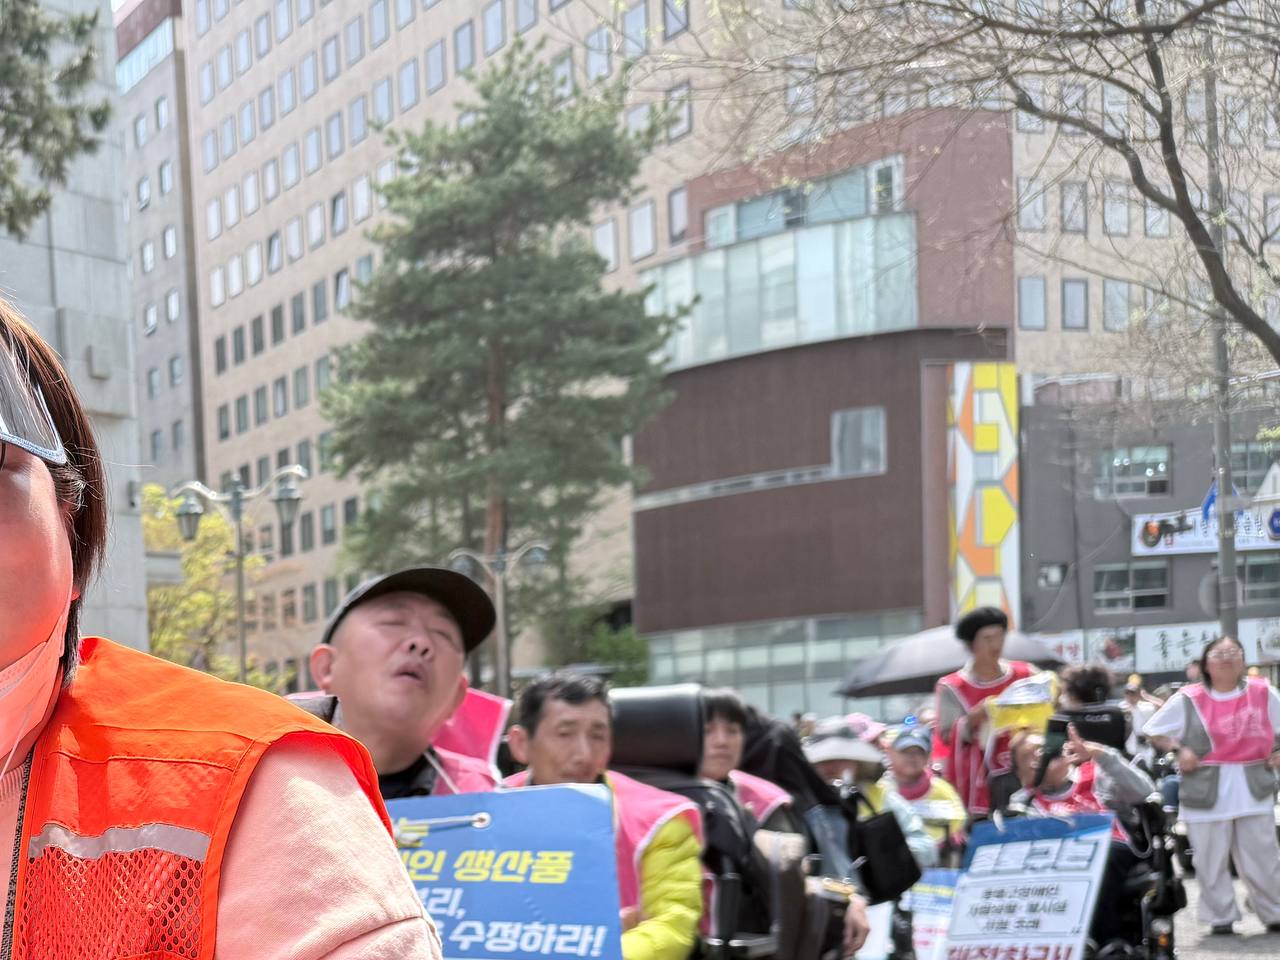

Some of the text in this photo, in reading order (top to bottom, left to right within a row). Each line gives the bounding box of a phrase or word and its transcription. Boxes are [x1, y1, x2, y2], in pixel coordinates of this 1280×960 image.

[401, 850, 575, 884] 인 생산품
[420, 887, 467, 919] 리,
[449, 920, 608, 957] 수정하라!
